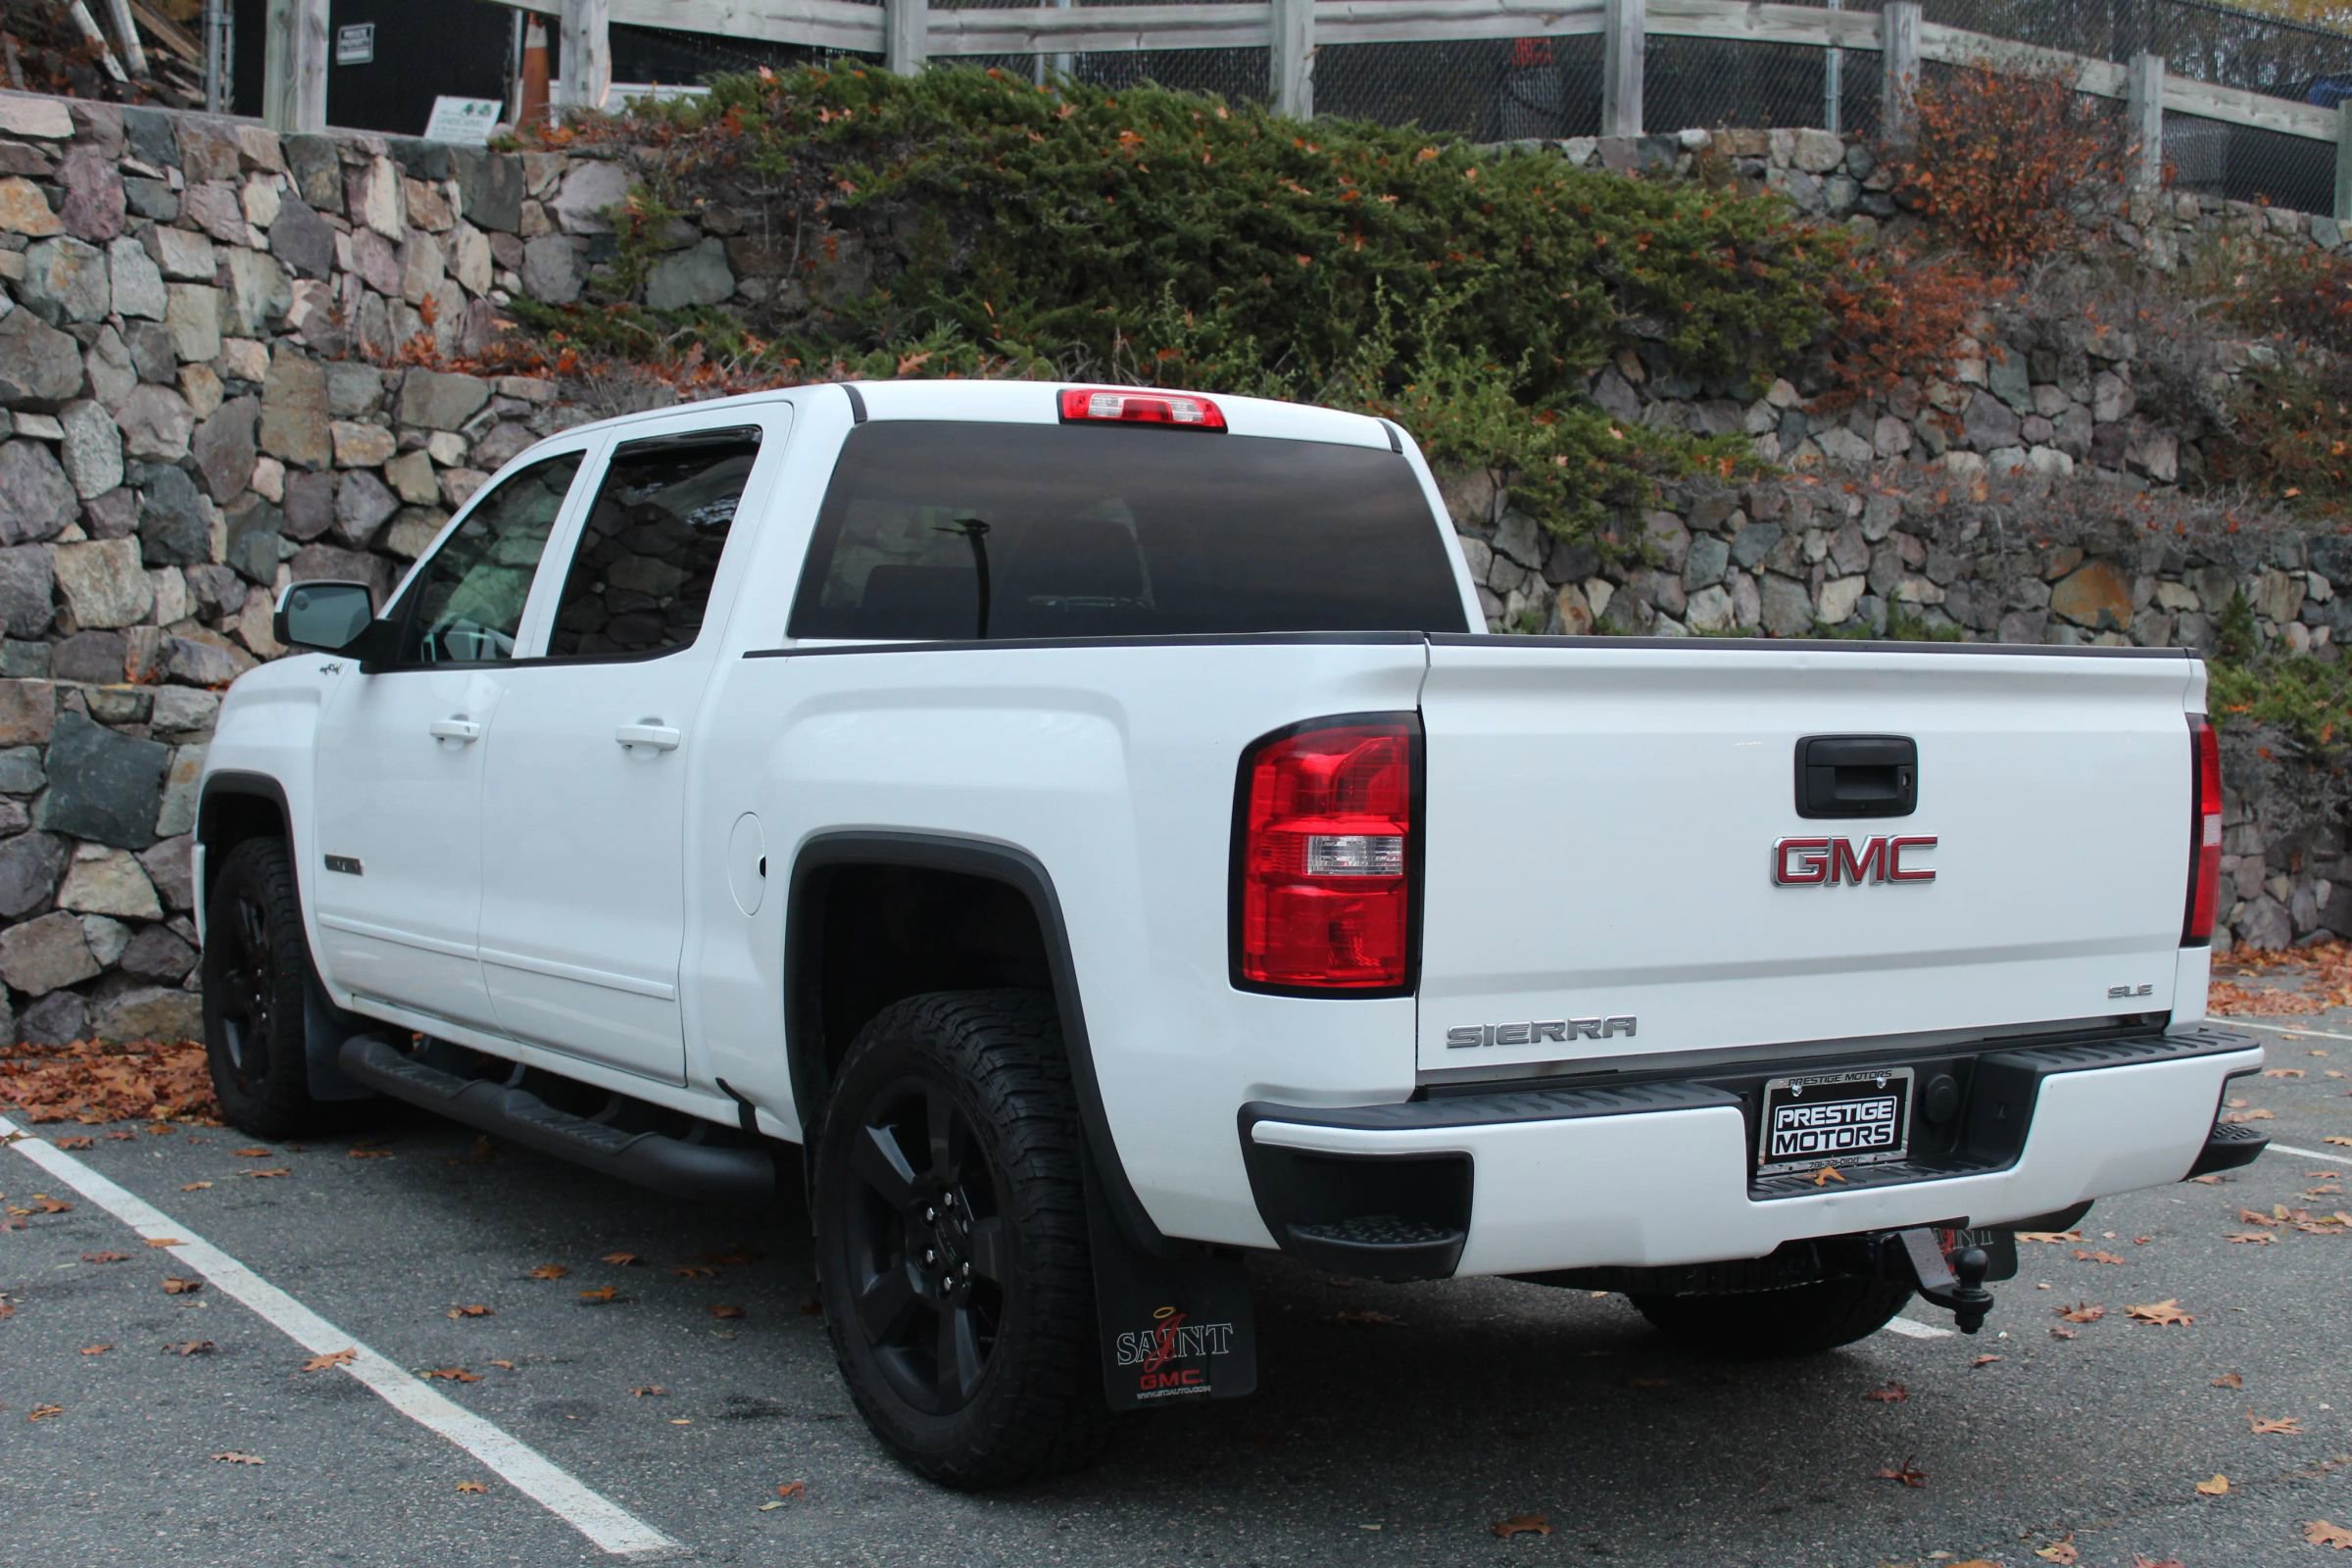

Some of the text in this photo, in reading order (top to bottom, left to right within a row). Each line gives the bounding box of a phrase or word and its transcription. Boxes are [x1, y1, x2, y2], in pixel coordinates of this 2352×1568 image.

[1770, 834, 1937, 888] GMC
[2108, 983, 2153, 999] SLE
[1446, 1014, 1637, 1049] SIERRA
[1788, 1070, 1892, 1087] PRESTIGE MOTORS
[1778, 1100, 1893, 1129] PRESTIGE
[1775, 1124, 1891, 1153] MOTORS
[1140, 1370, 1201, 1390] GMC
